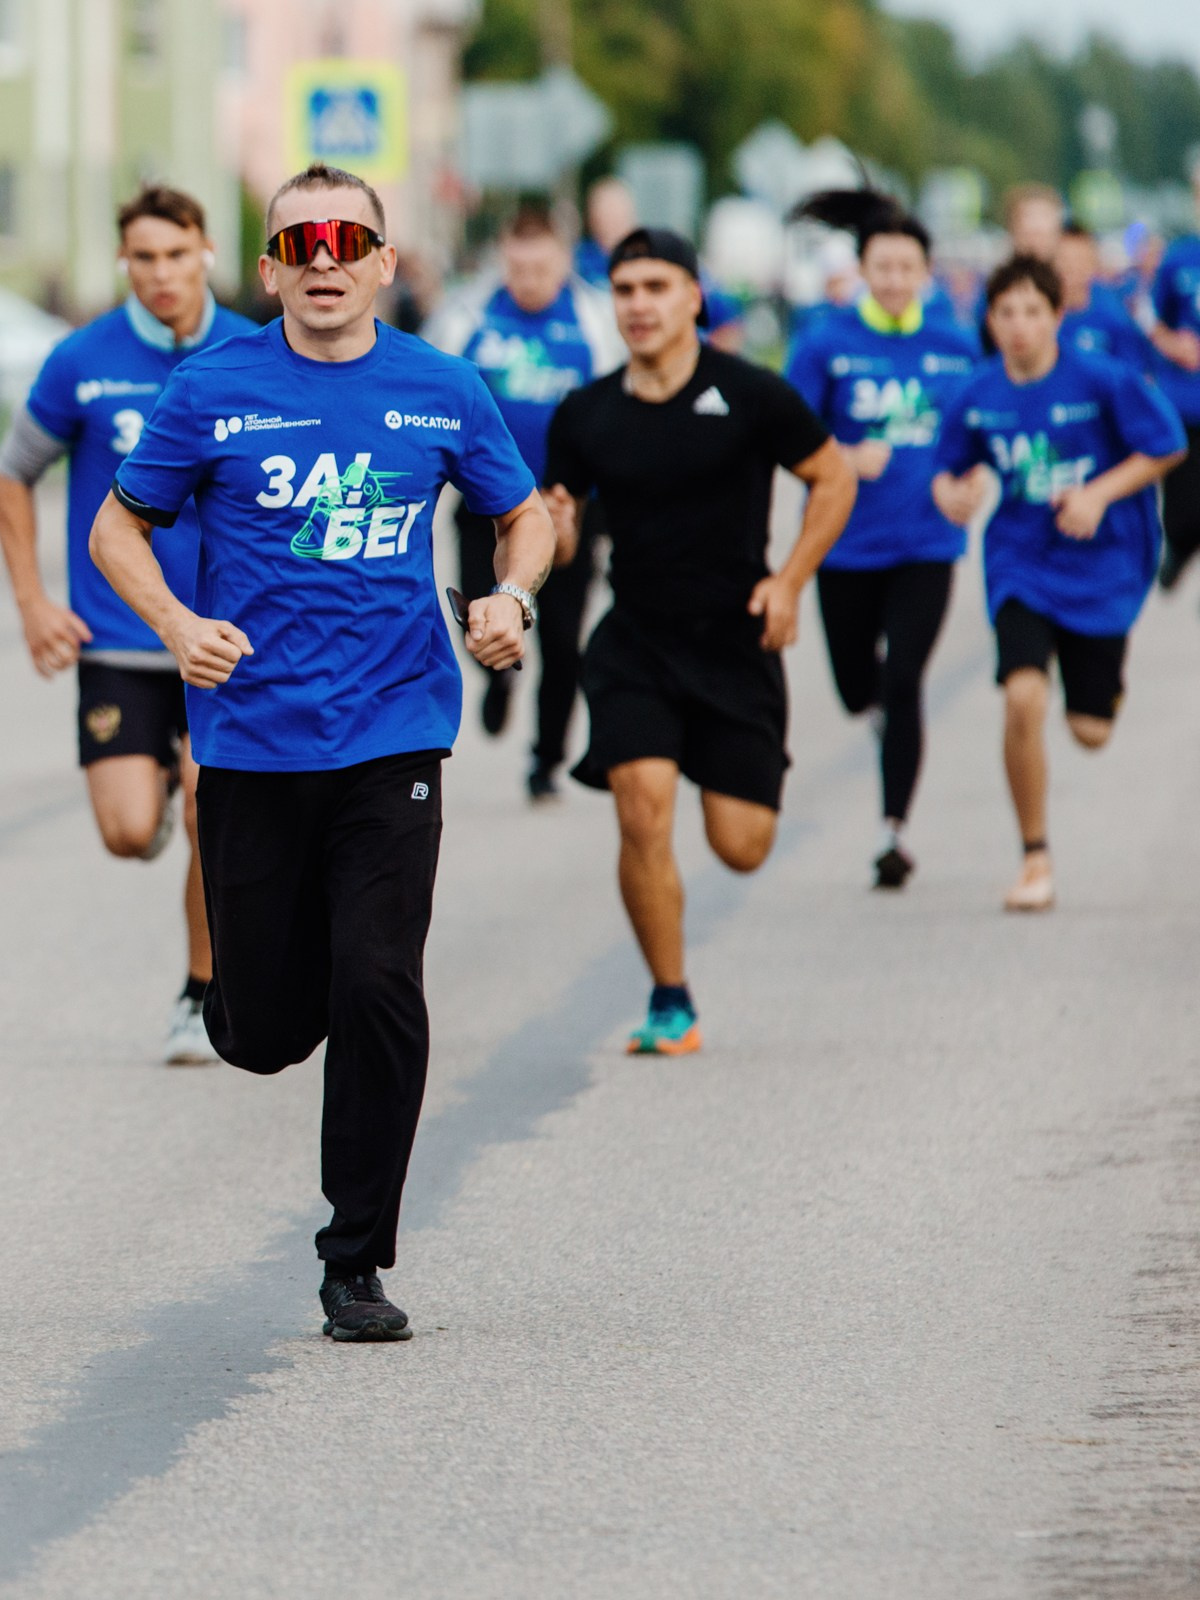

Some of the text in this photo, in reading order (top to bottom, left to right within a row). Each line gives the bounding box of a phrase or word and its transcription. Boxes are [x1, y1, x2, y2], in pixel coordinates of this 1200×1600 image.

[244, 419, 321, 432] ПРОМЫШЛЕННОСТИ
[404, 414, 461, 431] РОСАТОМ
[255, 453, 372, 509] ЗА!
[321, 500, 427, 560] БЕГ
